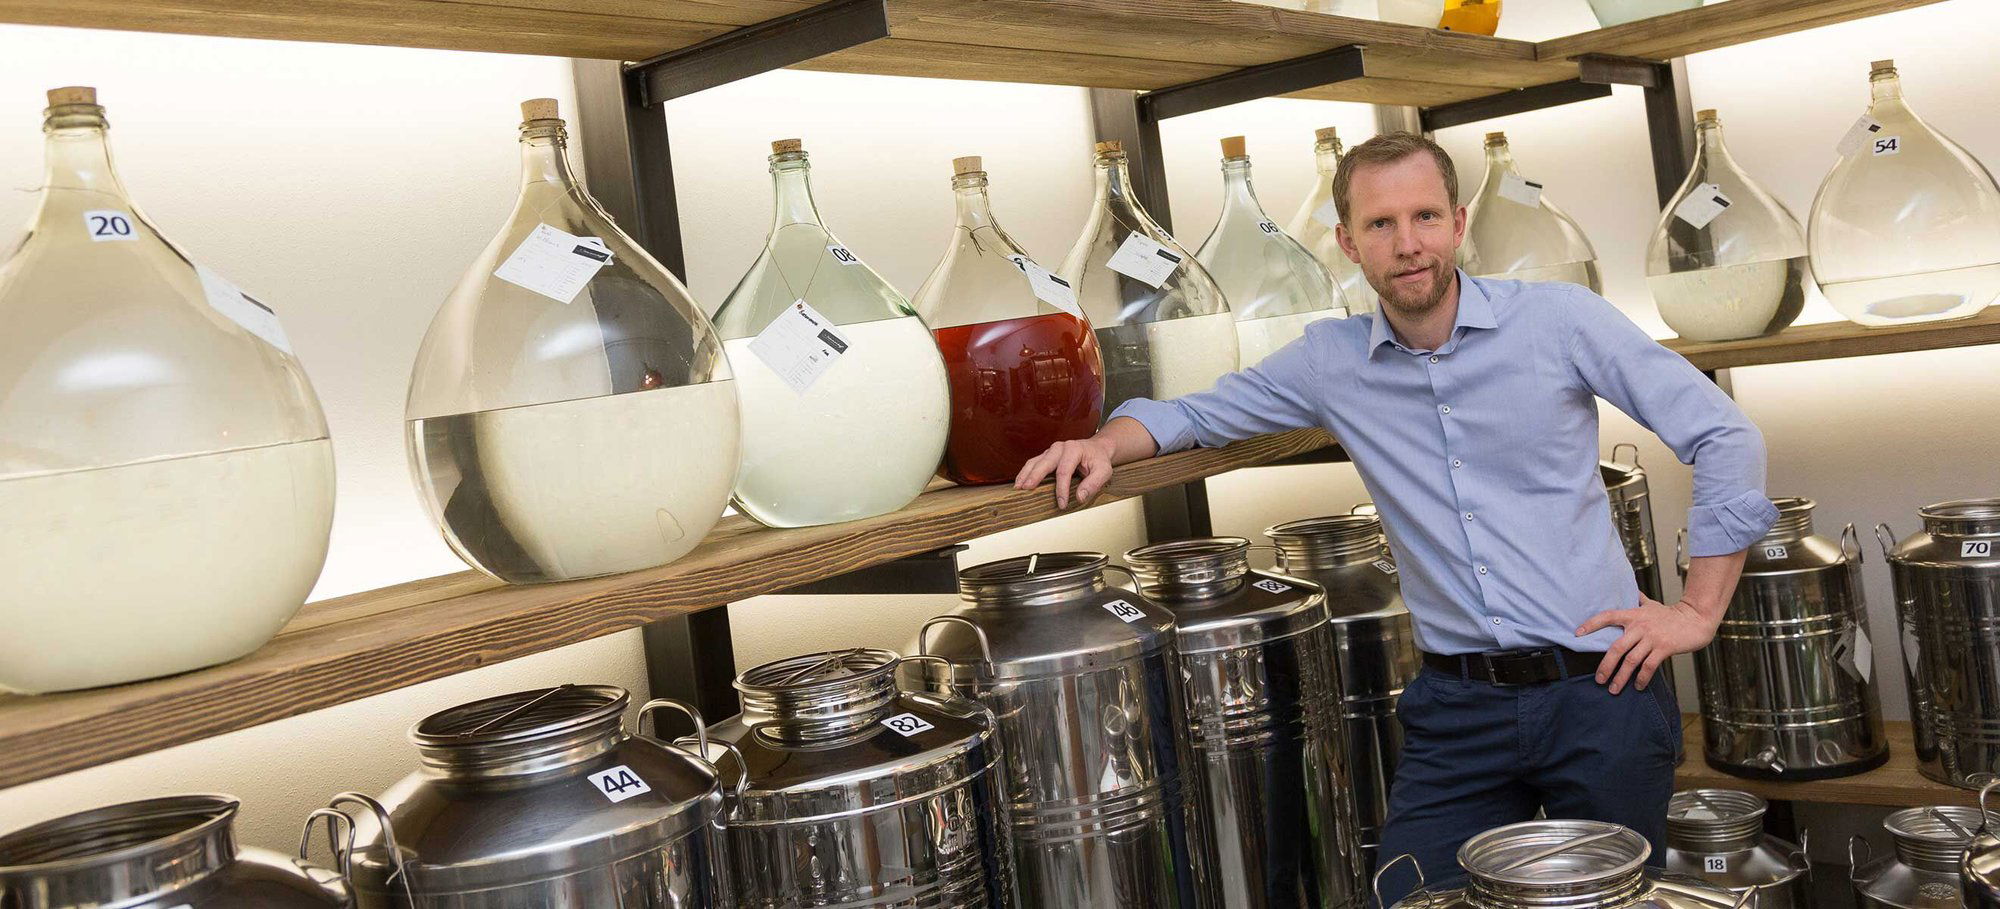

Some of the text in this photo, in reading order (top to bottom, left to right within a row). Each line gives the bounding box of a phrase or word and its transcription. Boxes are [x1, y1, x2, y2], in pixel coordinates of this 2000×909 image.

[1875, 138, 1898, 153] 54
[91, 216, 130, 236] 20
[1260, 222, 1278, 233] 06
[832, 248, 856, 261] 08
[1767, 548, 1785, 557] 03
[1965, 542, 1988, 554] 70
[1112, 602, 1139, 616] 46
[890, 716, 928, 732] 82
[603, 770, 641, 793] 44
[1708, 859, 1724, 870] 18
